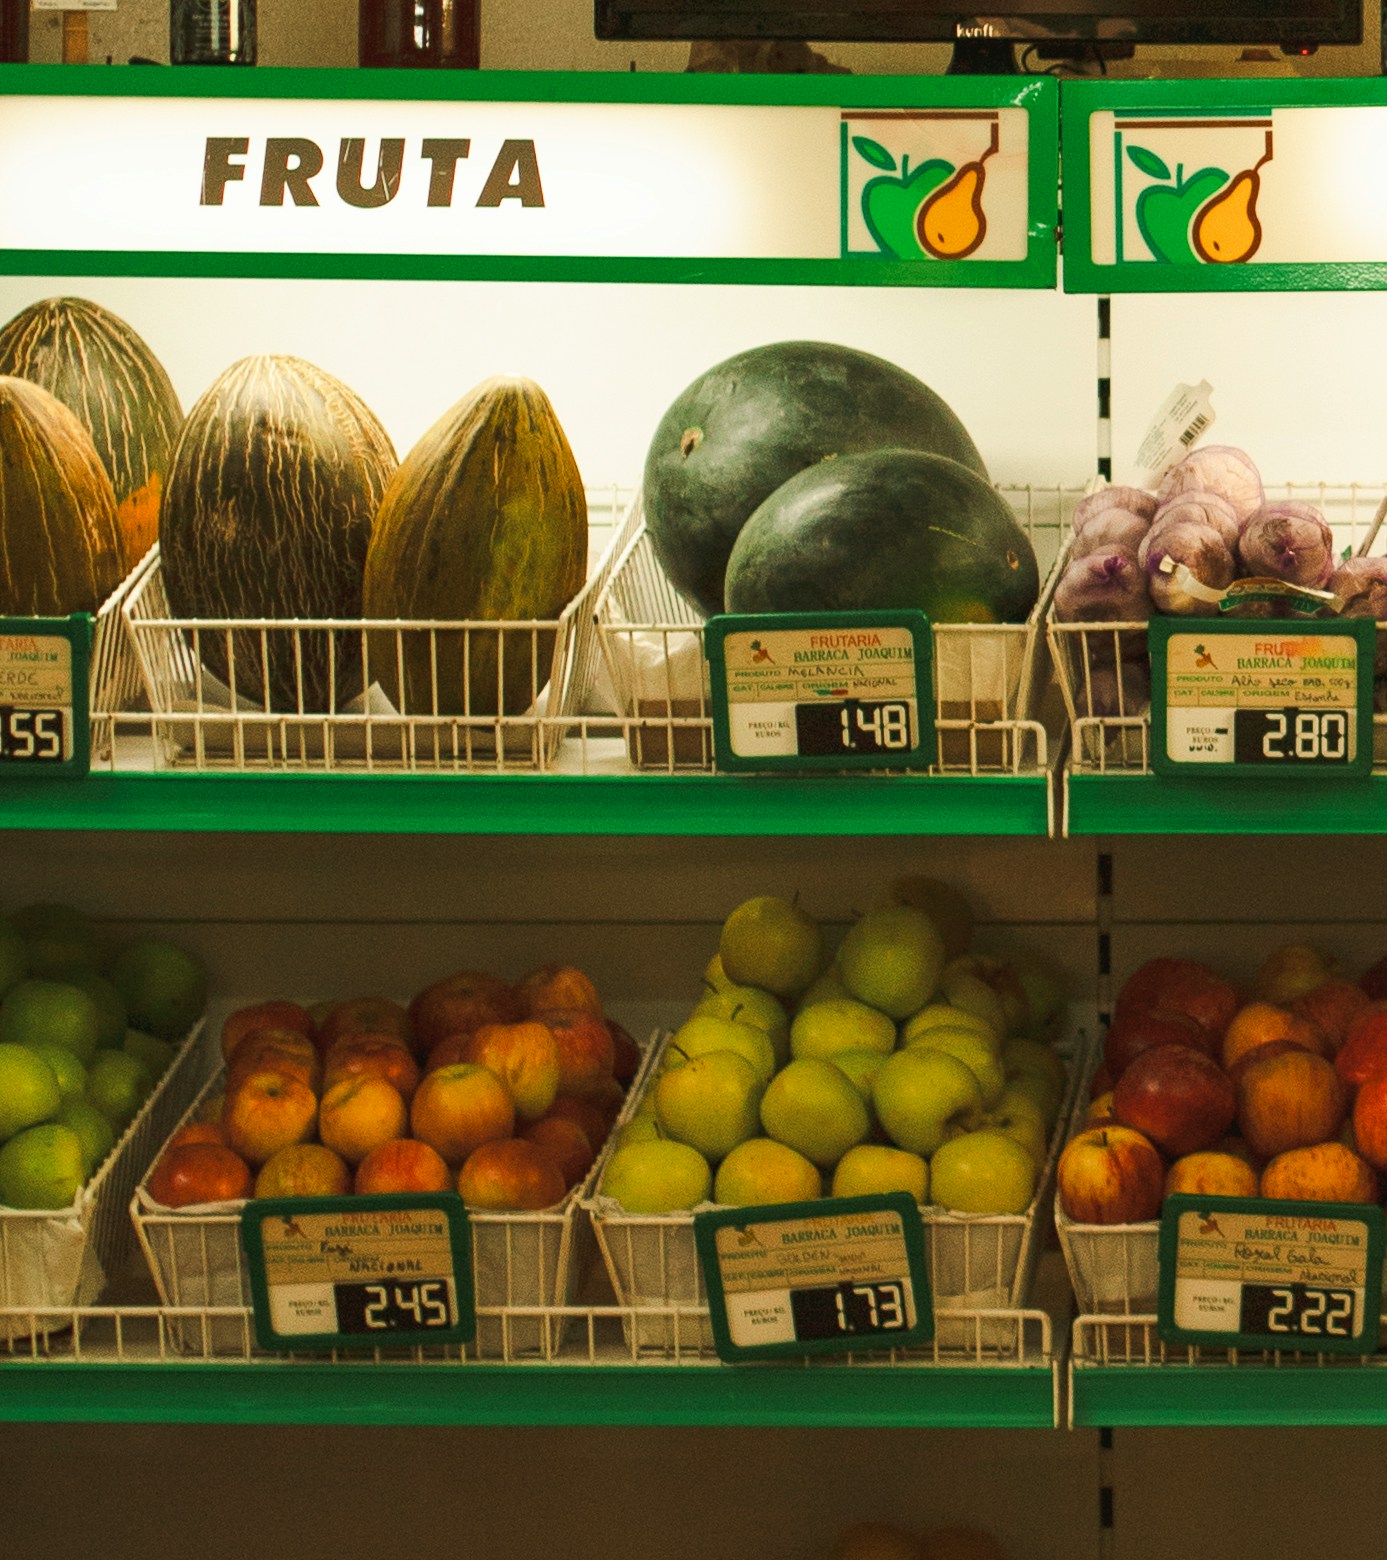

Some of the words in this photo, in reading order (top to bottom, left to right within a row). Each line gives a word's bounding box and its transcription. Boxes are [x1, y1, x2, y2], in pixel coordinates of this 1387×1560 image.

[199, 137, 546, 209] FRUTA
[794, 648, 849, 663] BARRACA
[857, 647, 912, 661] JOAQUIM
[810, 634, 881, 648] FRUTARIA
[788, 665, 865, 678] MELANCIA
[1237, 657, 1293, 670] BARRACA
[1300, 657, 1357, 671] JOAQUIM
[0, 712, 60, 758] .55
[840, 704, 908, 749] 1.48
[1262, 712, 1346, 759] 2.80
[781, 1228, 838, 1244] BARRACA
[845, 1223, 901, 1238] JOAQUIM
[1244, 1228, 1298, 1241] BARRACA
[1306, 1232, 1360, 1246] JOAQUIM
[364, 1283, 447, 1328] 2.45
[834, 1284, 904, 1331] 1.73
[1268, 1289, 1352, 1335] 2.22
